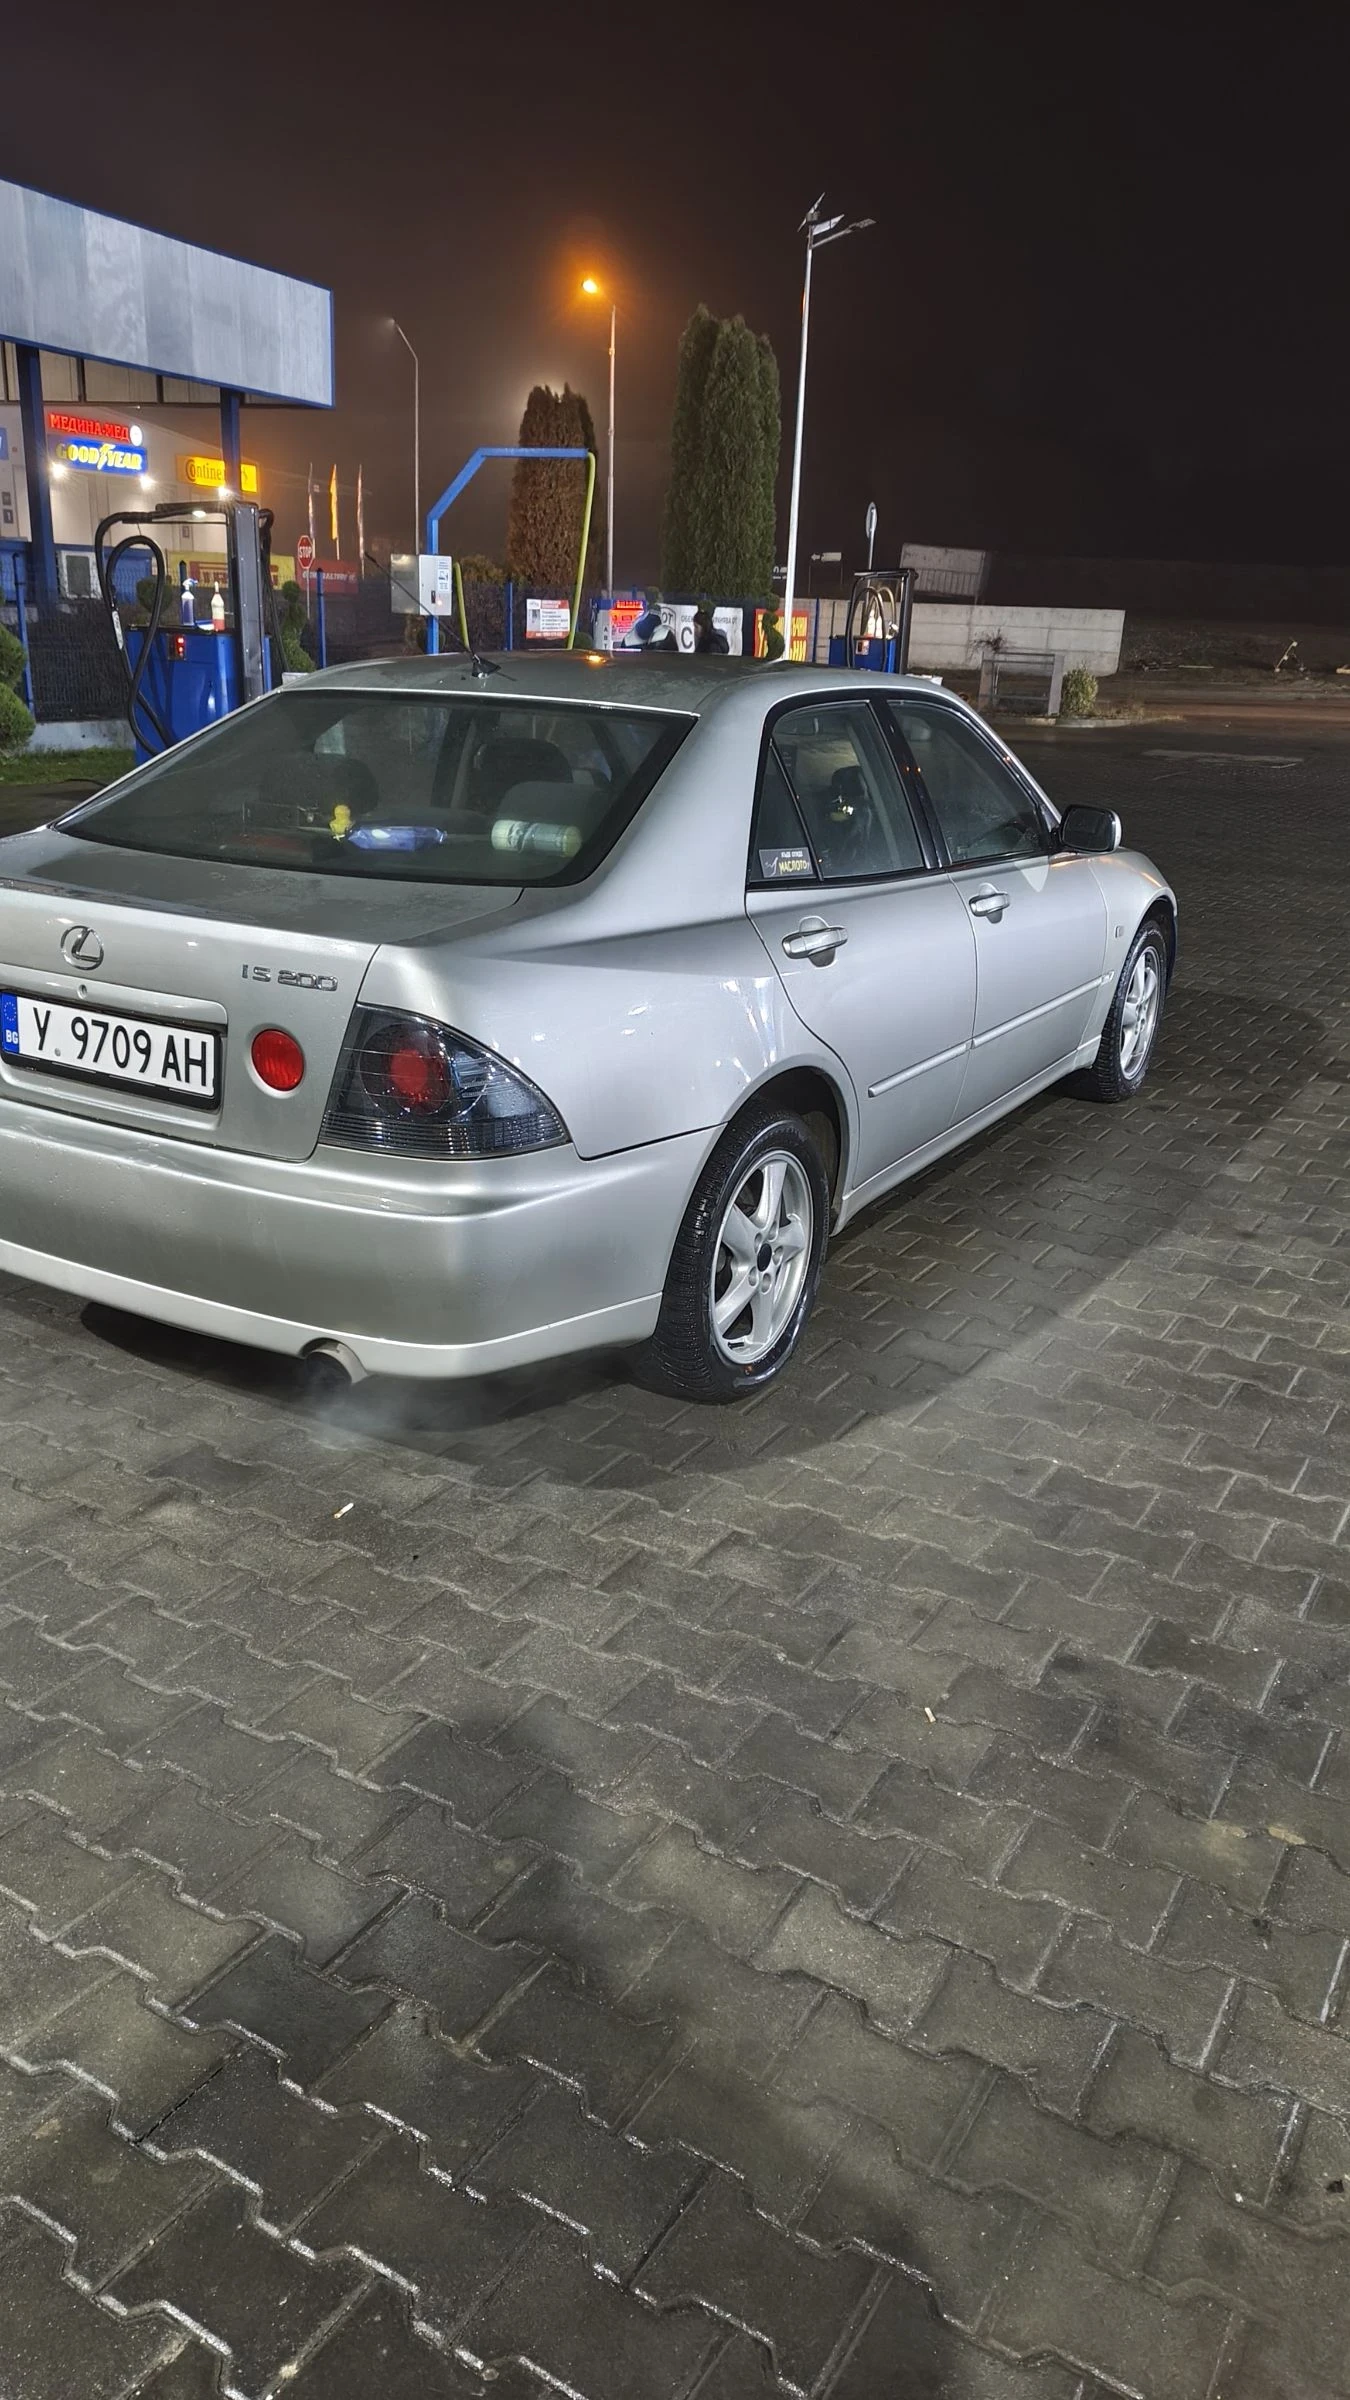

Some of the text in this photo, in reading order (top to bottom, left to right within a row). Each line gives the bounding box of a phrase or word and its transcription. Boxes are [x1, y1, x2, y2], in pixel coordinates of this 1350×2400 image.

[56, 443, 143, 471] GOODYEAR
[299, 546, 313, 559] STOP
[242, 964, 339, 992] IS 200
[5, 1029, 19, 1044] BG
[71, 1016, 151, 1074] 9709
